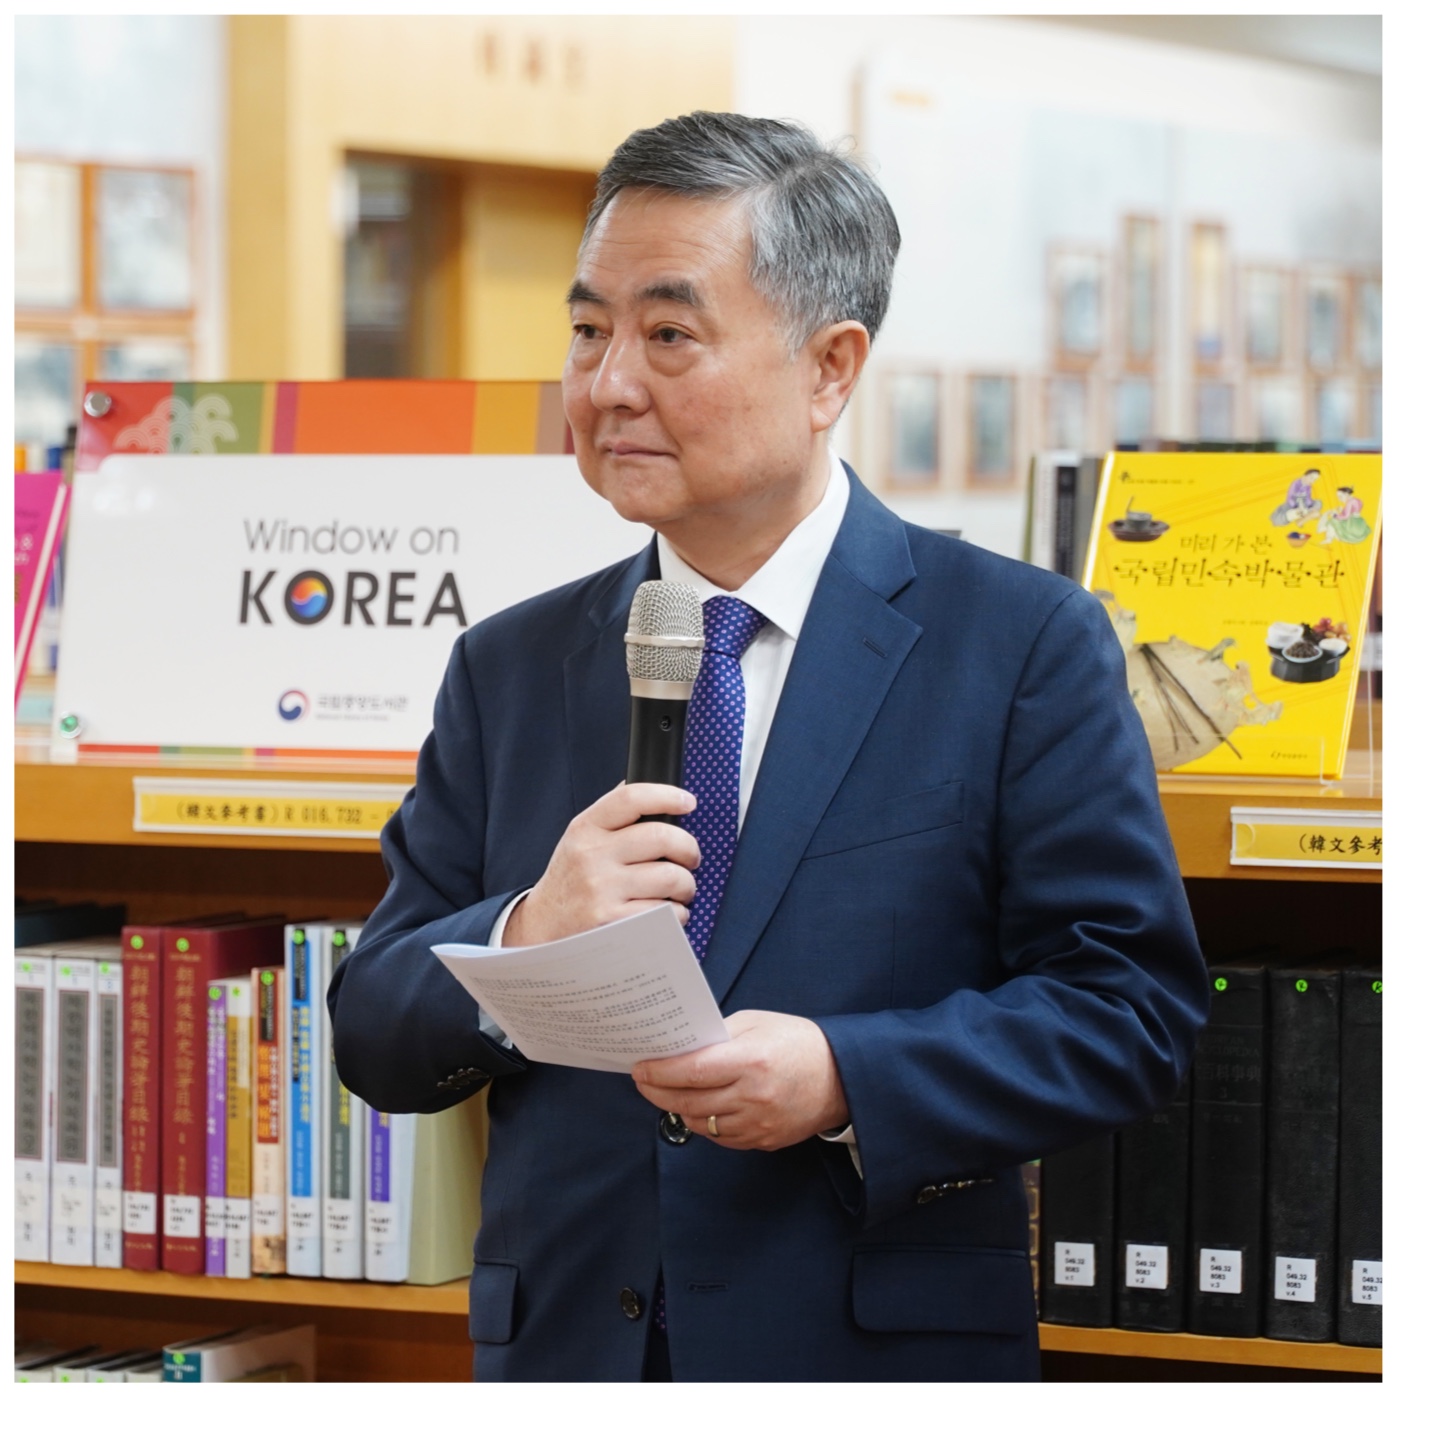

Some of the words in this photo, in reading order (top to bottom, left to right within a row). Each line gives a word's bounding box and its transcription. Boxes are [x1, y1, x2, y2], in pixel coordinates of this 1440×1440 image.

[244, 518, 400, 555] Window
[409, 525, 460, 555] on
[1180, 533, 1217, 553] 미리
[1224, 533, 1245, 553] 가
[1250, 534, 1273, 556] 본
[1113, 557, 1346, 589] 국립민속박물관
[238, 569, 468, 628] KOREA
